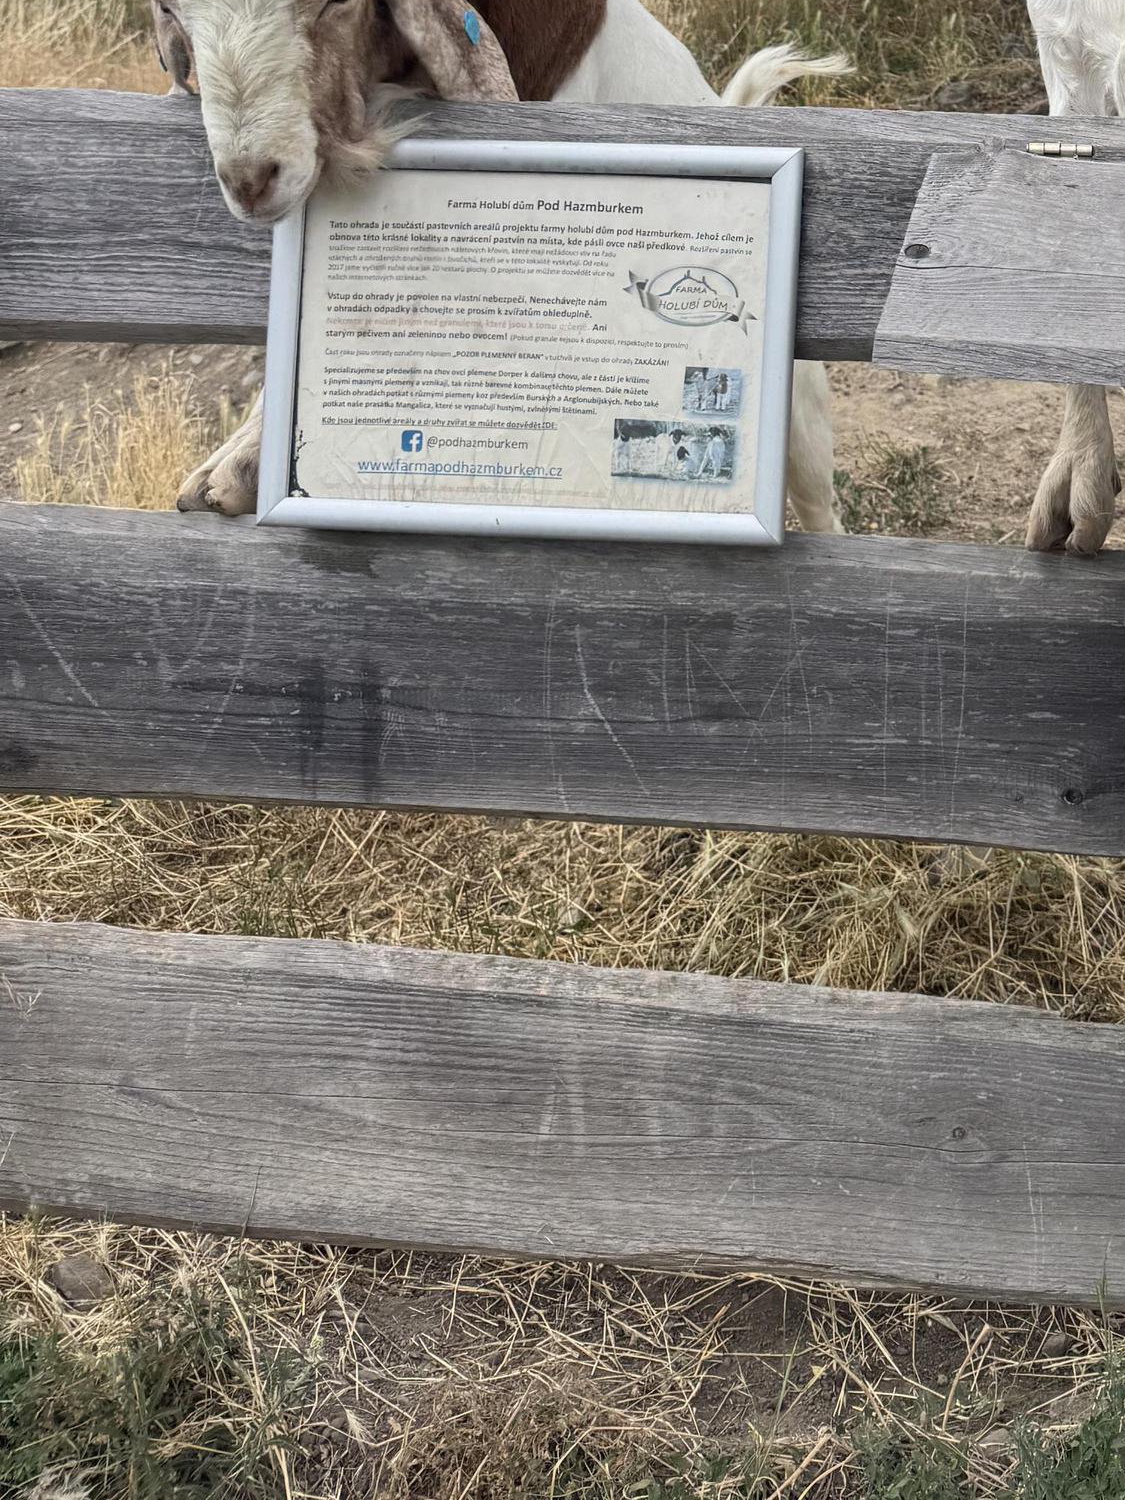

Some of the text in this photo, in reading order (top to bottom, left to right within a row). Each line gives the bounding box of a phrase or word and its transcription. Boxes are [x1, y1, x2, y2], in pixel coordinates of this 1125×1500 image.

[447, 198, 643, 214] Farma Holubí dům Pod Hazmburkem
[329, 219, 348, 228] Tato
[350, 220, 380, 229] ohrada
[381, 220, 390, 231] je
[426, 221, 472, 232] pastevních
[502, 222, 539, 234] projektu
[540, 223, 565, 235] farmy
[567, 224, 594, 234] holubí
[595, 226, 615, 235] dům
[616, 227, 634, 237] pod
[635, 227, 694, 239] Hazmburkem.
[695, 230, 719, 240] Jehož
[721, 232, 744, 241] cílem
[745, 233, 754, 244] je
[329, 232, 361, 241] obnova
[410, 233, 442, 243] lokality
[450, 233, 492, 243] navrácení
[493, 234, 525, 245] pastvin
[539, 236, 565, 247] místa,
[567, 237, 582, 246] kde
[627, 240, 644, 249] naši
[675, 285, 707, 294] FARMA
[328, 291, 350, 301] Vstup
[352, 291, 363, 300] do
[365, 291, 394, 302] ohrady
[453, 293, 481, 302] vlastní
[529, 295, 586, 307] Nenechávejte
[587, 297, 607, 306] nám
[659, 297, 728, 311] HOLUBÍ DŮM
[333, 303, 372, 312] ohradách
[374, 304, 410, 315] odpadky
[467, 306, 496, 317] prosím
[504, 307, 541, 316] zvířatům
[542, 308, 592, 320] ohleduplně.
[325, 328, 354, 339] starým
[392, 329, 406, 338] ani
[448, 330, 471, 339] nebo
[591, 322, 607, 331] Ani
[434, 367, 450, 375] chov
[498, 369, 522, 379] Dorper
[581, 373, 592, 381] ale
[386, 389, 409, 398] potkat
[451, 379, 462, 387] tak
[605, 385, 621, 394] Dále
[322, 399, 345, 408] potkat
[322, 416, 336, 425] Kde
[337, 416, 353, 425] jsou
[392, 417, 415, 426] areály
[423, 417, 446, 427] druhy
[427, 436, 528, 450] @podhazmburkem
[358, 459, 562, 478] www.farmapodhazmburkem.cz
